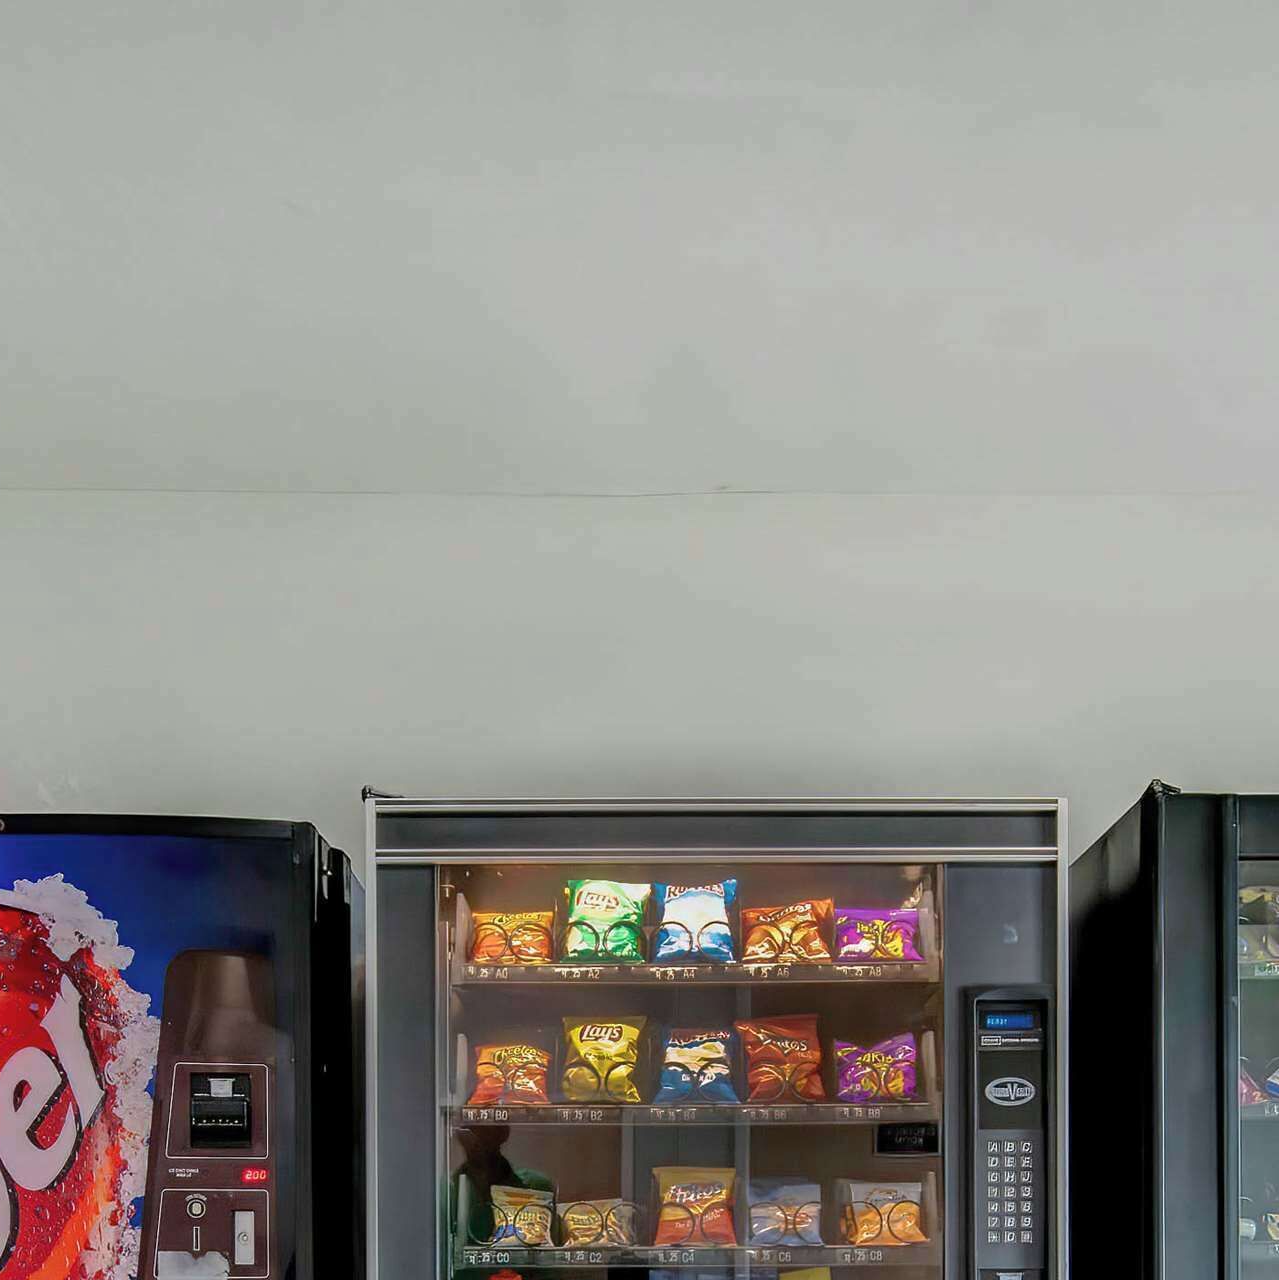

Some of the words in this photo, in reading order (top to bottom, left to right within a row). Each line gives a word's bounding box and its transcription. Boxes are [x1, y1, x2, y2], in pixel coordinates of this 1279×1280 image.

[495, 1110, 508, 1121] B0
[590, 1110, 603, 1121] B2
[497, 1252, 510, 1263] C0
[590, 1253, 602, 1263] C2
[682, 1252, 694, 1263] C4
[778, 1252, 792, 1262] C6
